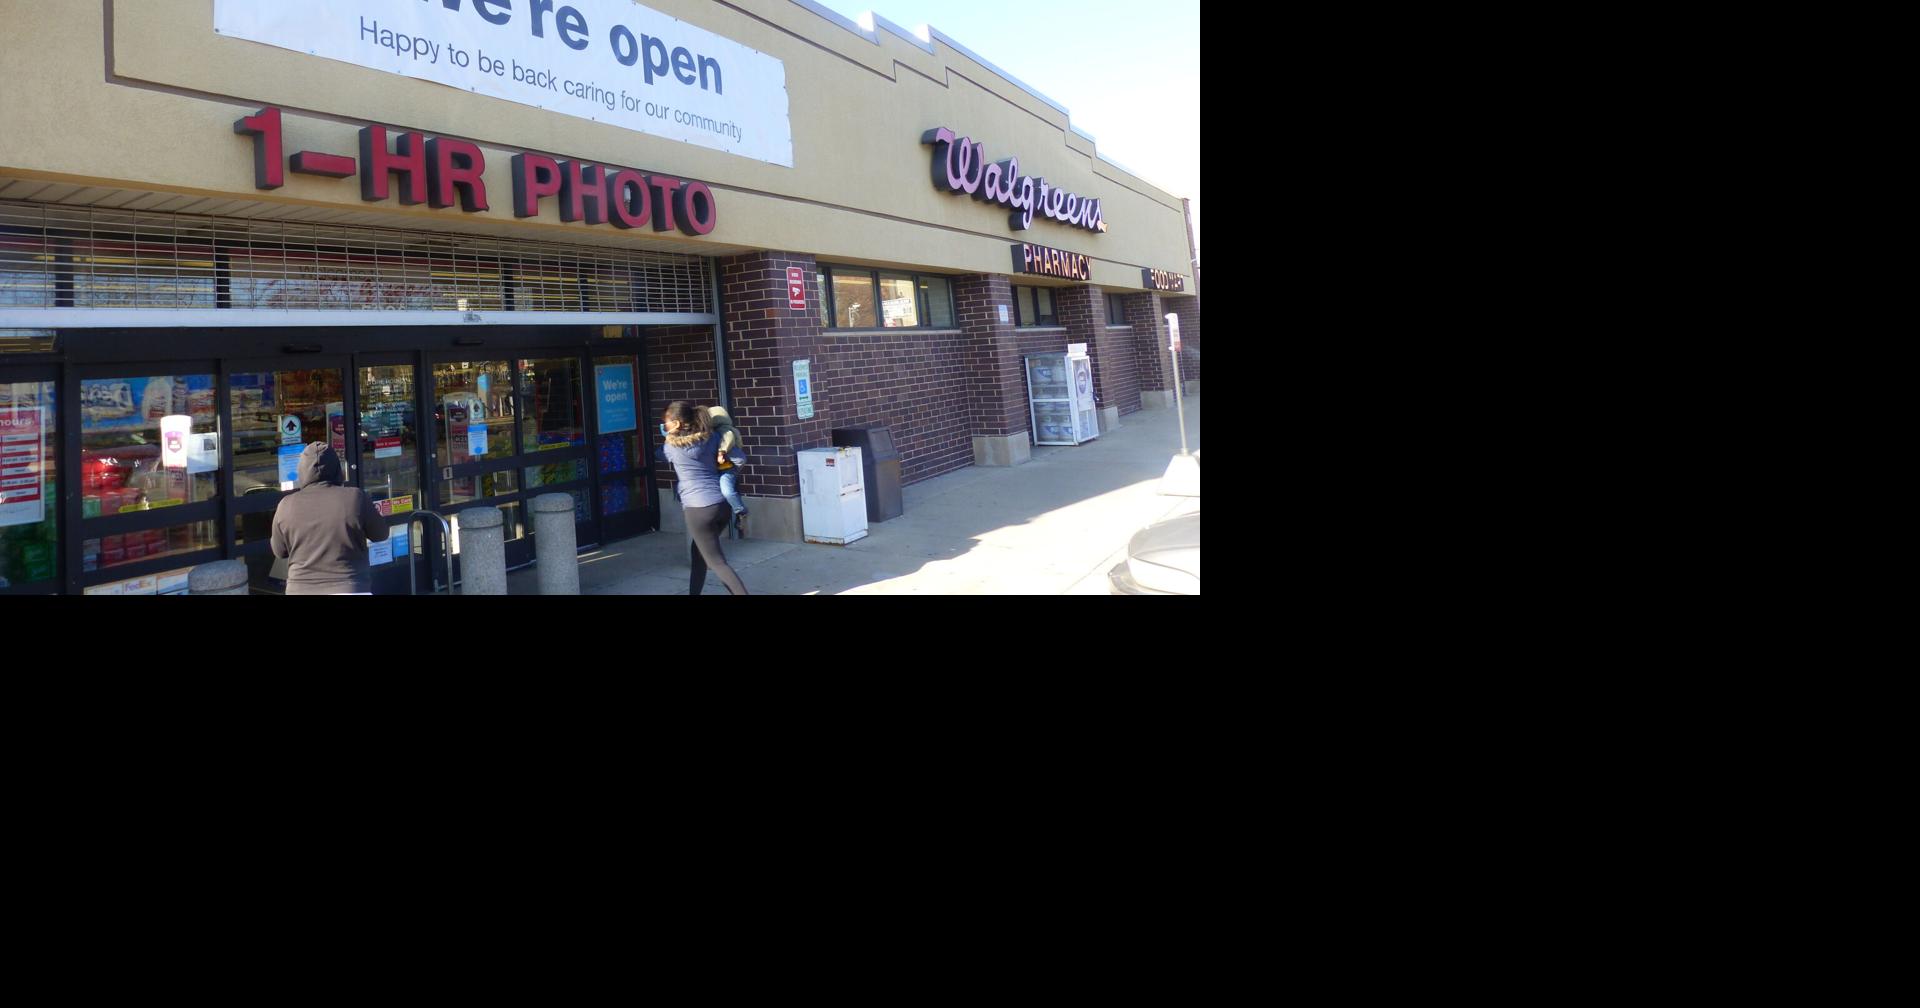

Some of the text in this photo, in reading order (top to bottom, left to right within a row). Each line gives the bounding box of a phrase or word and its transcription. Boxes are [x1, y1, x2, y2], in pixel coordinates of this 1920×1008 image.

[360, 15, 742, 143] Happy to be back caring for our community
[609, 24, 723, 96] open
[236, 107, 717, 237] 1-HR PHOTO
[932, 126, 1108, 231] Walgreens
[1022, 243, 1093, 281] PHARMACY
[602, 378, 628, 391] We're
[605, 392, 628, 404] open
